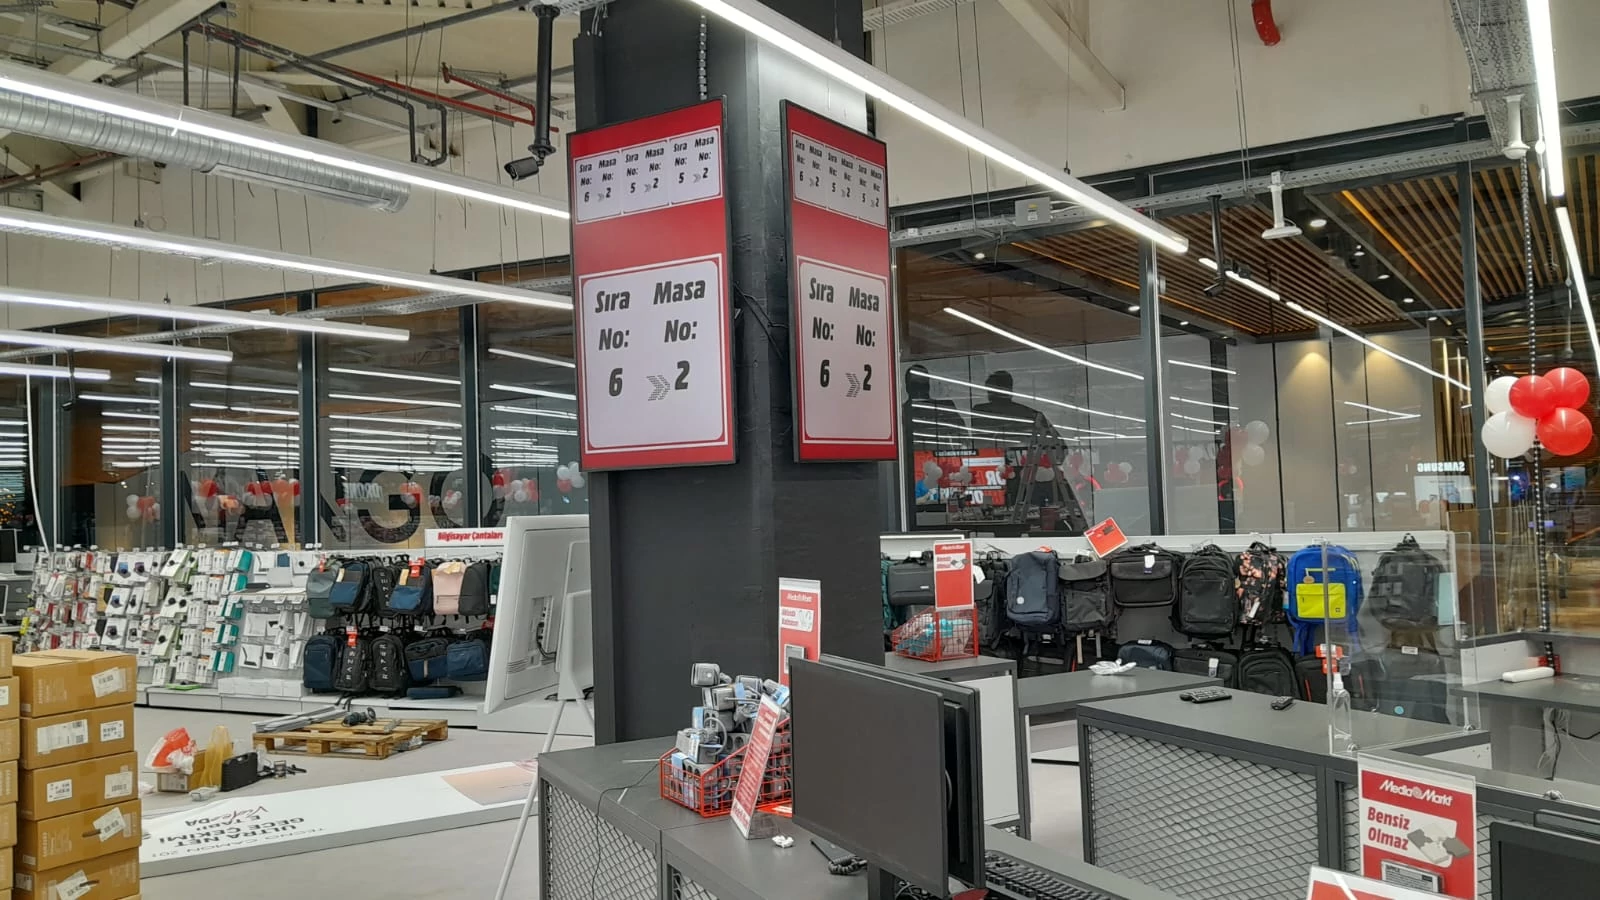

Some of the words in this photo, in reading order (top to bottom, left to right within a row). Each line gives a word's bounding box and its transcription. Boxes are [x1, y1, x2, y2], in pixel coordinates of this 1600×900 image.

[694, 136, 715, 148] Masa
[645, 147, 664, 159] Masa
[598, 157, 617, 169] Masa
[678, 172, 684, 184] 5
[702, 168, 708, 179] 2
[815, 176, 820, 187] 2
[630, 182, 636, 193] 5
[652, 178, 659, 189] 2
[846, 187, 851, 198] 2
[584, 191, 590, 202] 6
[605, 187, 611, 199] 2
[875, 198, 879, 207] 2
[595, 290, 631, 314] Sıra
[653, 279, 706, 305] Masa
[809, 277, 834, 303] Sıra
[848, 286, 879, 312] Masa
[598, 327, 630, 351] No:
[664, 319, 698, 343] No:
[812, 316, 834, 341] No:
[856, 324, 876, 347] No:
[608, 367, 623, 397] 6
[674, 360, 690, 391] 2
[819, 359, 830, 388] 6
[862, 363, 872, 391] 2
[437, 531, 471, 542] Bilgisayar
[248, 817, 304, 831] GECE
[1367, 806, 1411, 831] Bensiz
[226, 825, 297, 839] ULTRA
[1367, 827, 1410, 851] Olmaz
[174, 836, 219, 847] NET
